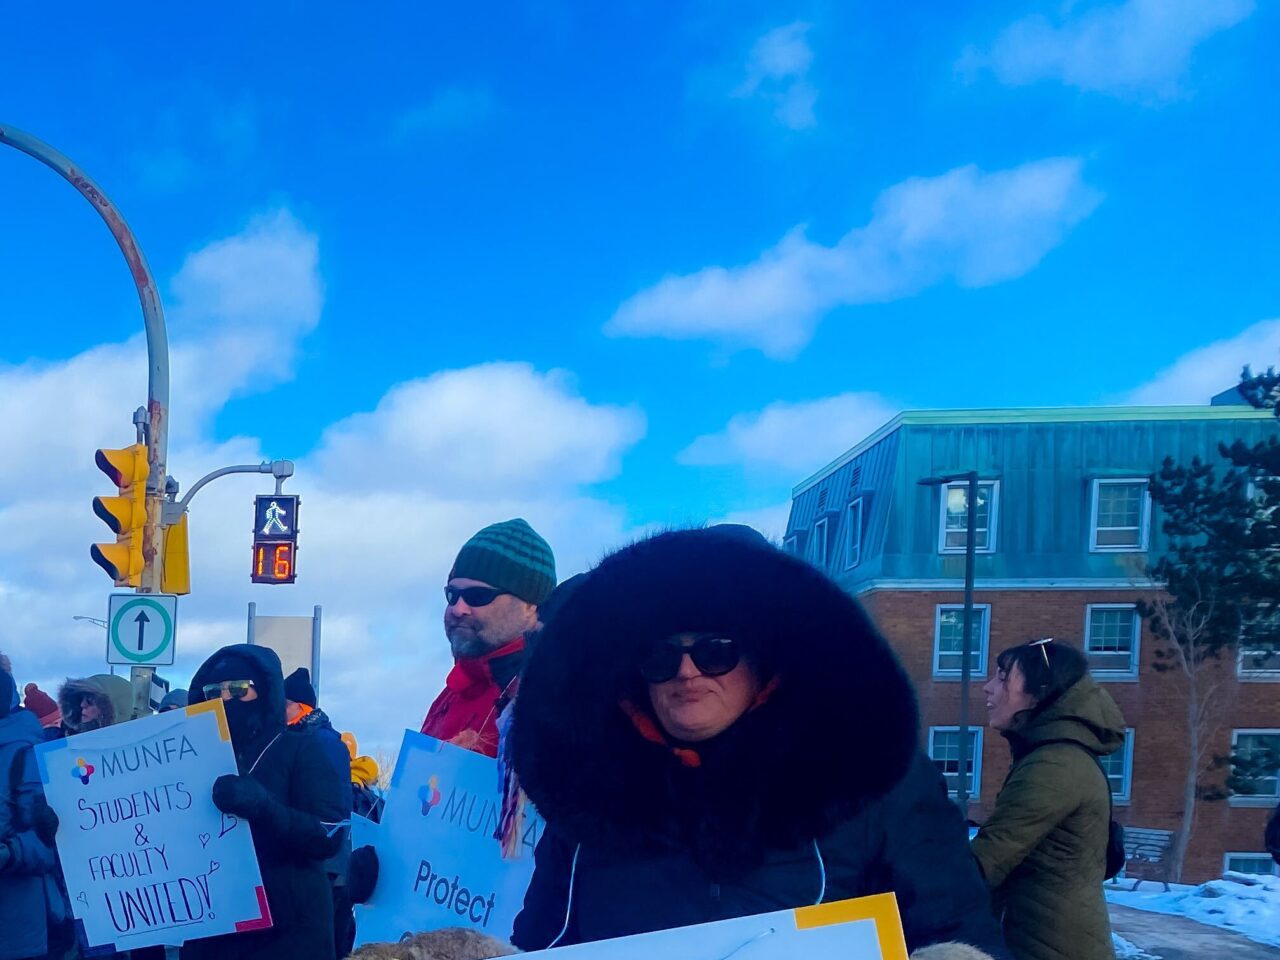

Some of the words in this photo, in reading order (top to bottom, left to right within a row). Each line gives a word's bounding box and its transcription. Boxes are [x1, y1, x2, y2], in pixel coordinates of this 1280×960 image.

[258, 547, 289, 579] 16
[100, 734, 198, 779] MUNFA
[77, 781, 192, 831] STUDENTS
[134, 823, 150, 847] &
[88, 843, 169, 882] FACULTY
[105, 873, 216, 933] UNITED!
[413, 859, 496, 928] Protect
